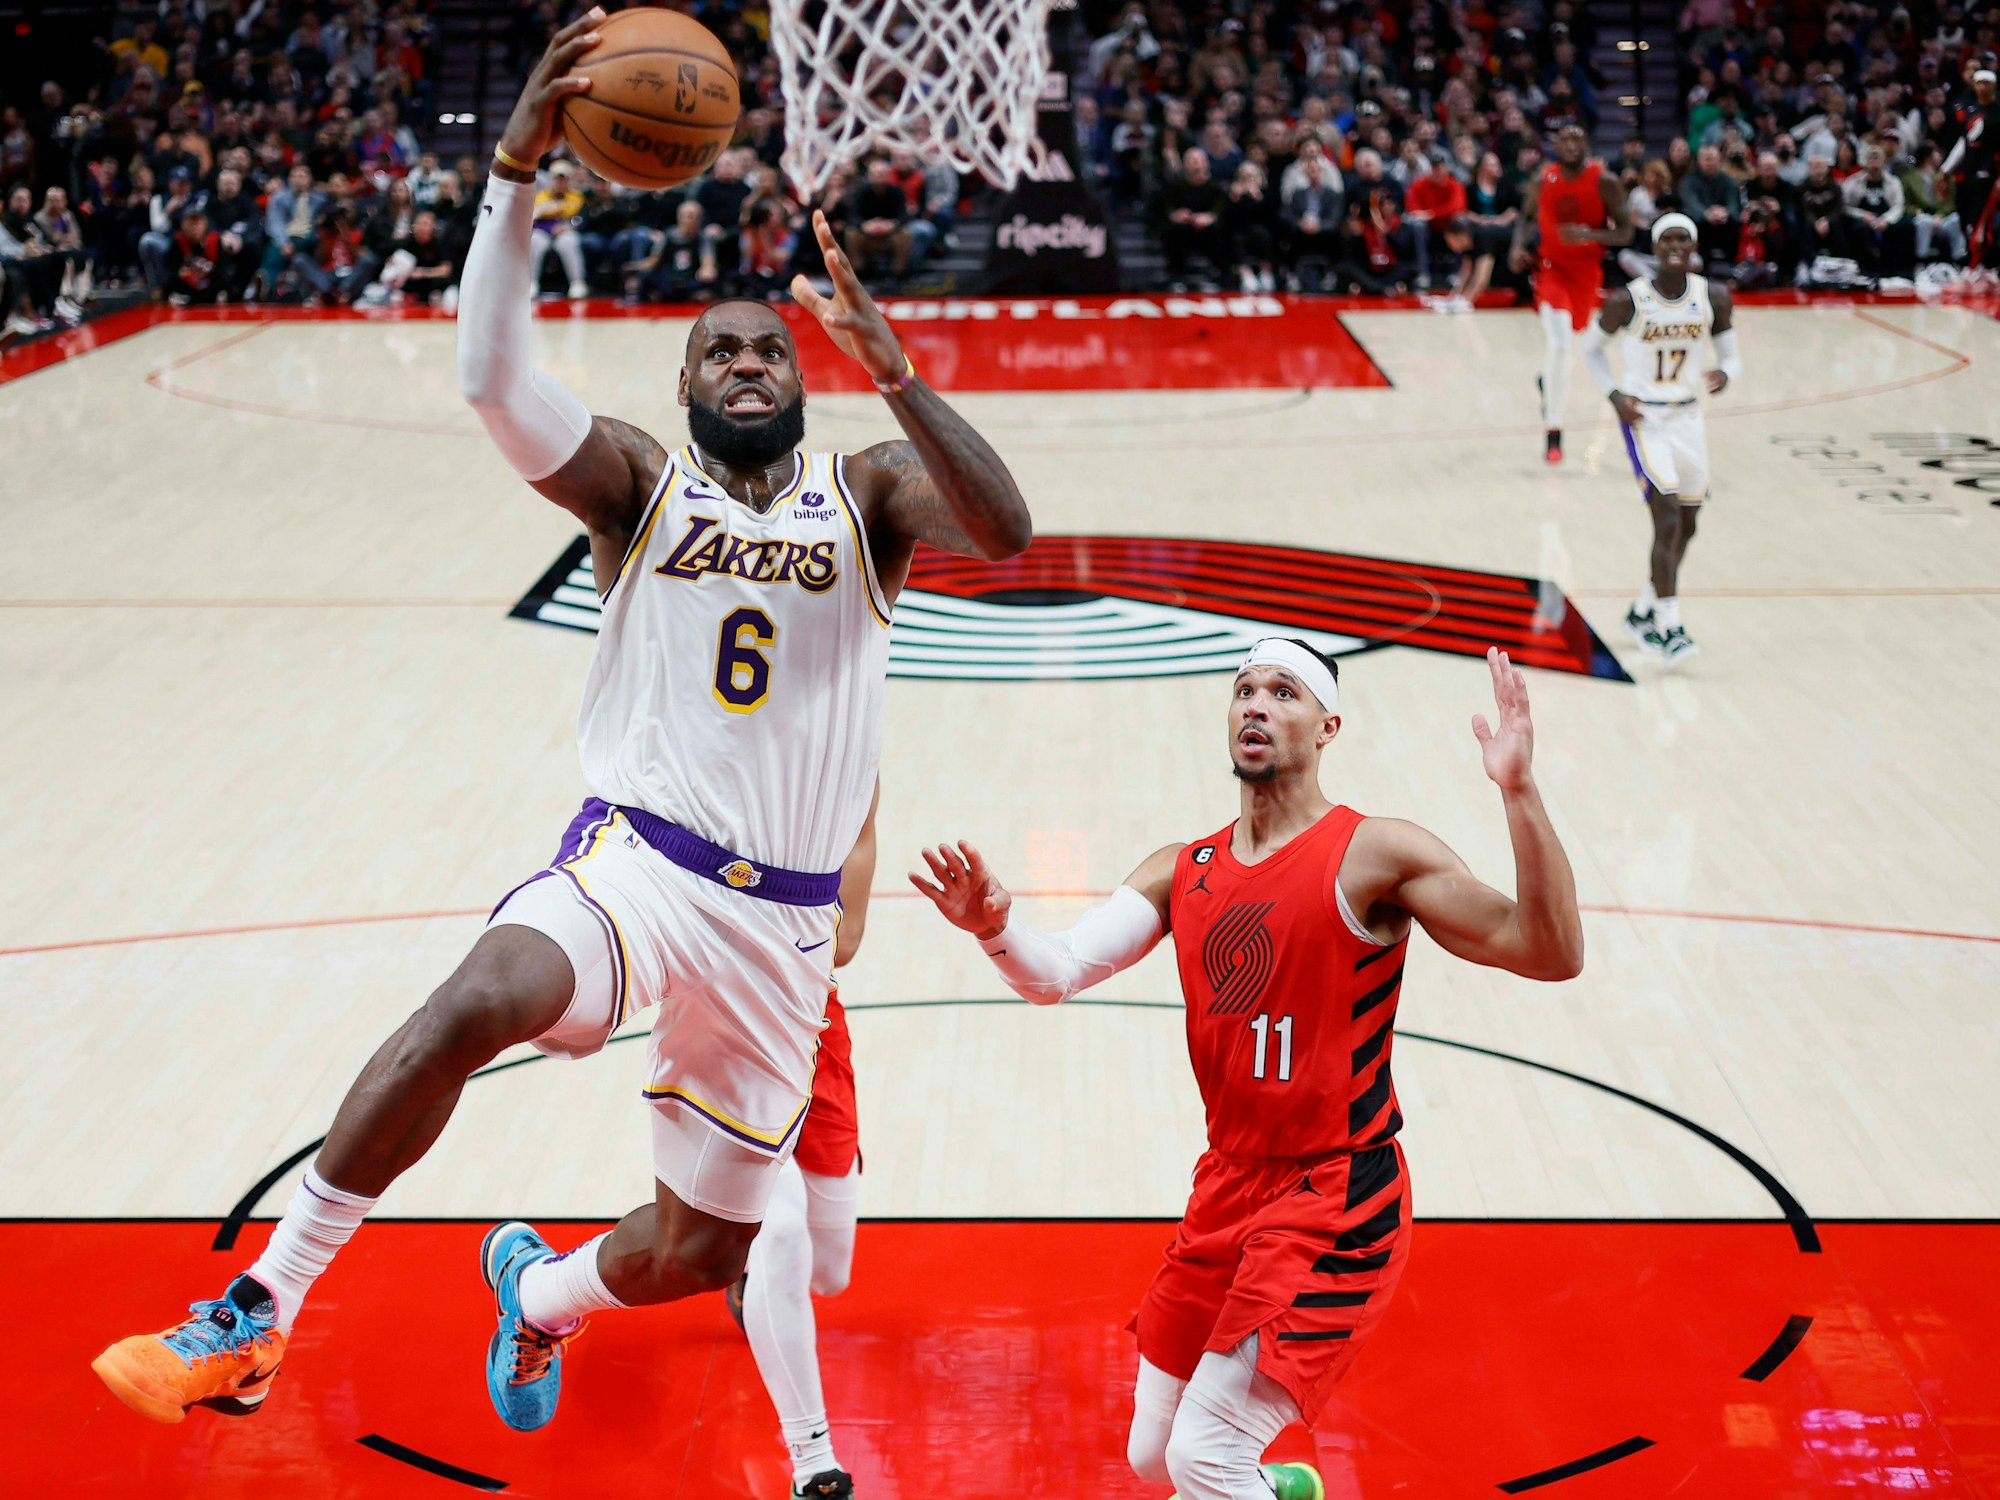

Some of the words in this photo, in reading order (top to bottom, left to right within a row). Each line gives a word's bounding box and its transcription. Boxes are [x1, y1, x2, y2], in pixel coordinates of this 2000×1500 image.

[610, 121, 720, 168] Wilson
[997, 214, 1107, 258] ripcity
[875, 298, 1285, 320] ORTLAND
[1655, 349, 1687, 384] 17
[793, 507, 837, 521] bibigo
[652, 515, 840, 594] LAKERS
[712, 605, 778, 715] 6
[1195, 846, 1214, 864] 6
[1250, 1012, 1294, 1082] 11
